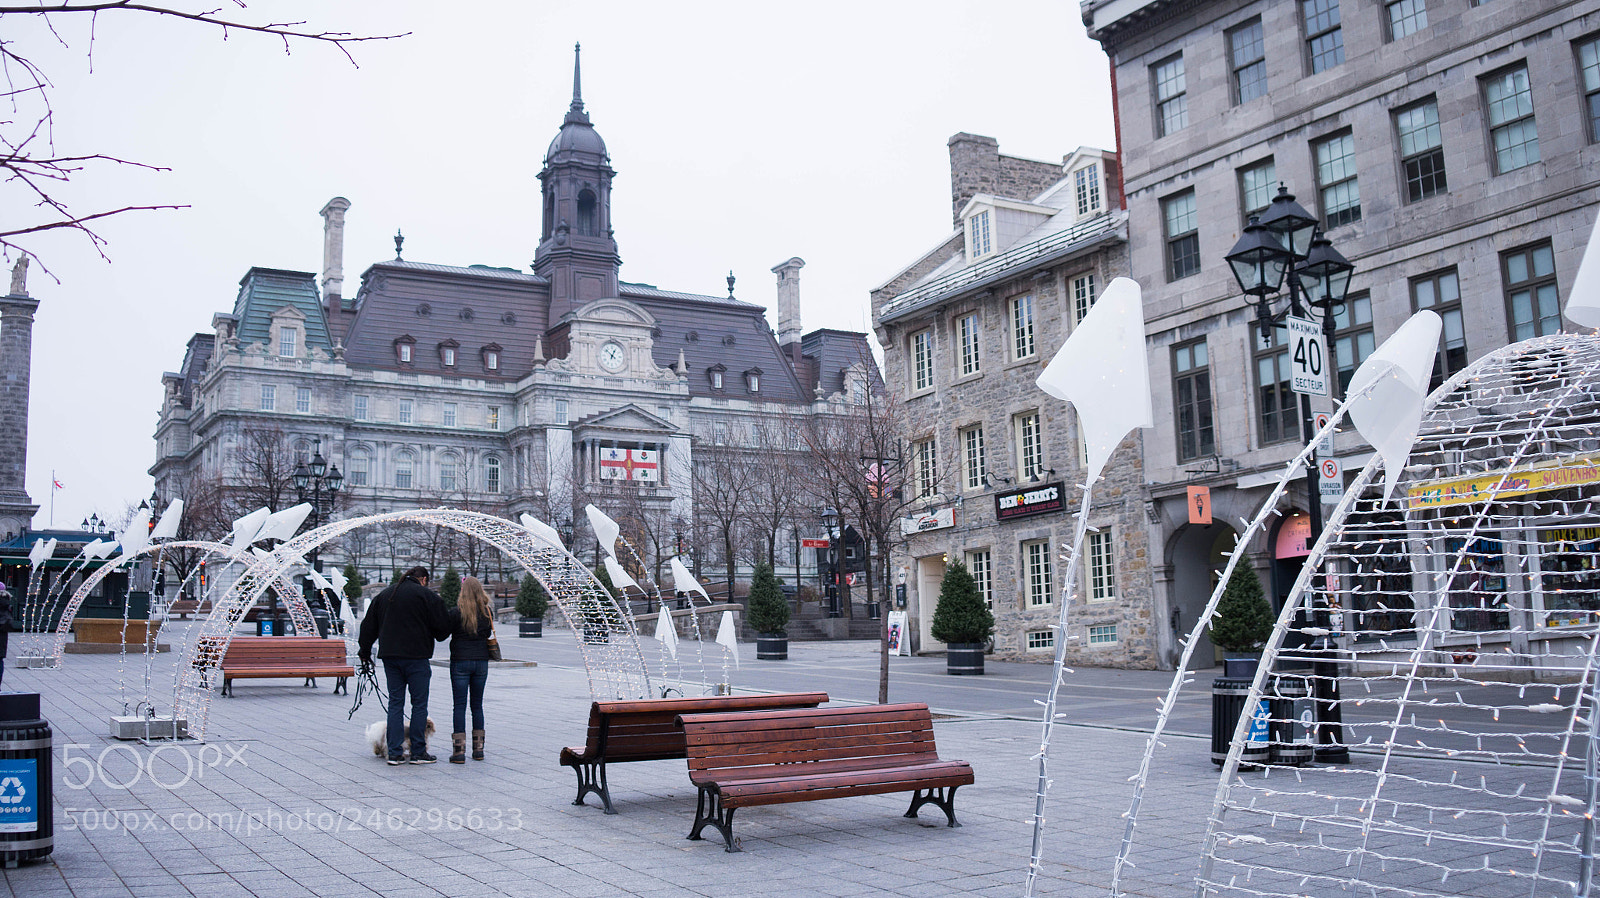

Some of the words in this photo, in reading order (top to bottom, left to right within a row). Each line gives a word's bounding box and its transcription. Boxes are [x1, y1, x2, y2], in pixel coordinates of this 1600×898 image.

[1290, 321, 1319, 335] MAXIMUM
[1294, 336, 1322, 376] 40
[1295, 377, 1323, 391] SECTEUR
[1543, 467, 1598, 486] SOUVENIRS
[999, 495, 1018, 510] BEN
[1023, 487, 1059, 505] JERRY'S
